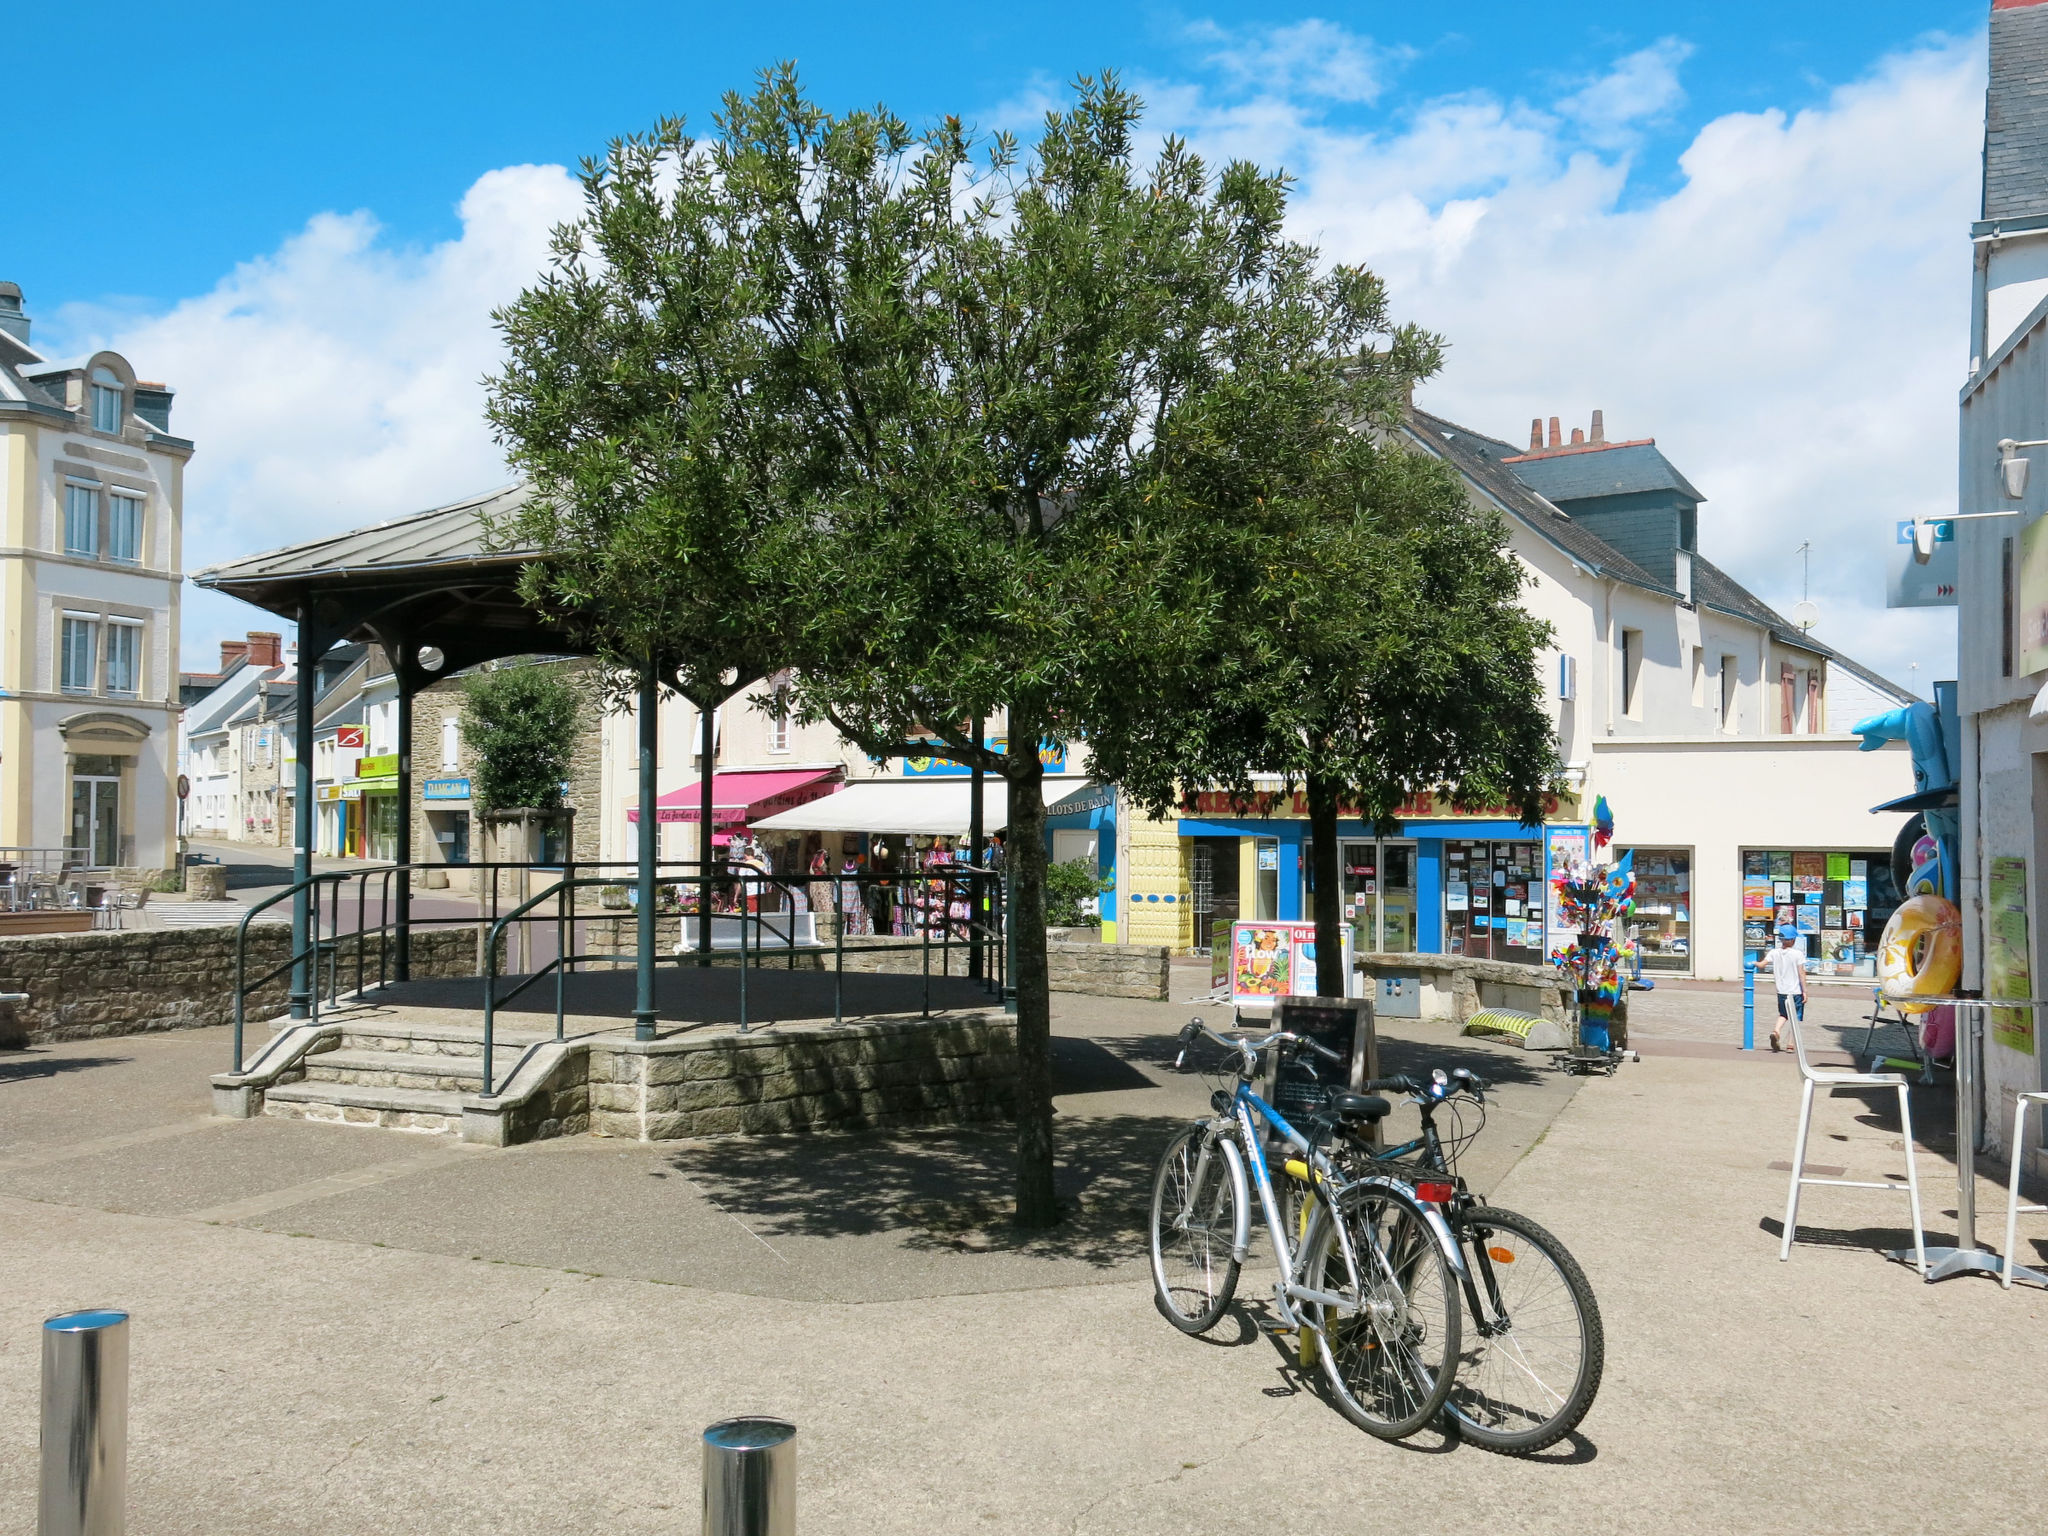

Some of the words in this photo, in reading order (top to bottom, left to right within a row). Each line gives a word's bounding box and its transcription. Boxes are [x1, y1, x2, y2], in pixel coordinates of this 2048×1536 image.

[1902, 522, 1948, 540] CC
[1046, 803, 1074, 816] LLOTS
[1075, 800, 1087, 813] DE
[1088, 794, 1112, 810] BAIN
